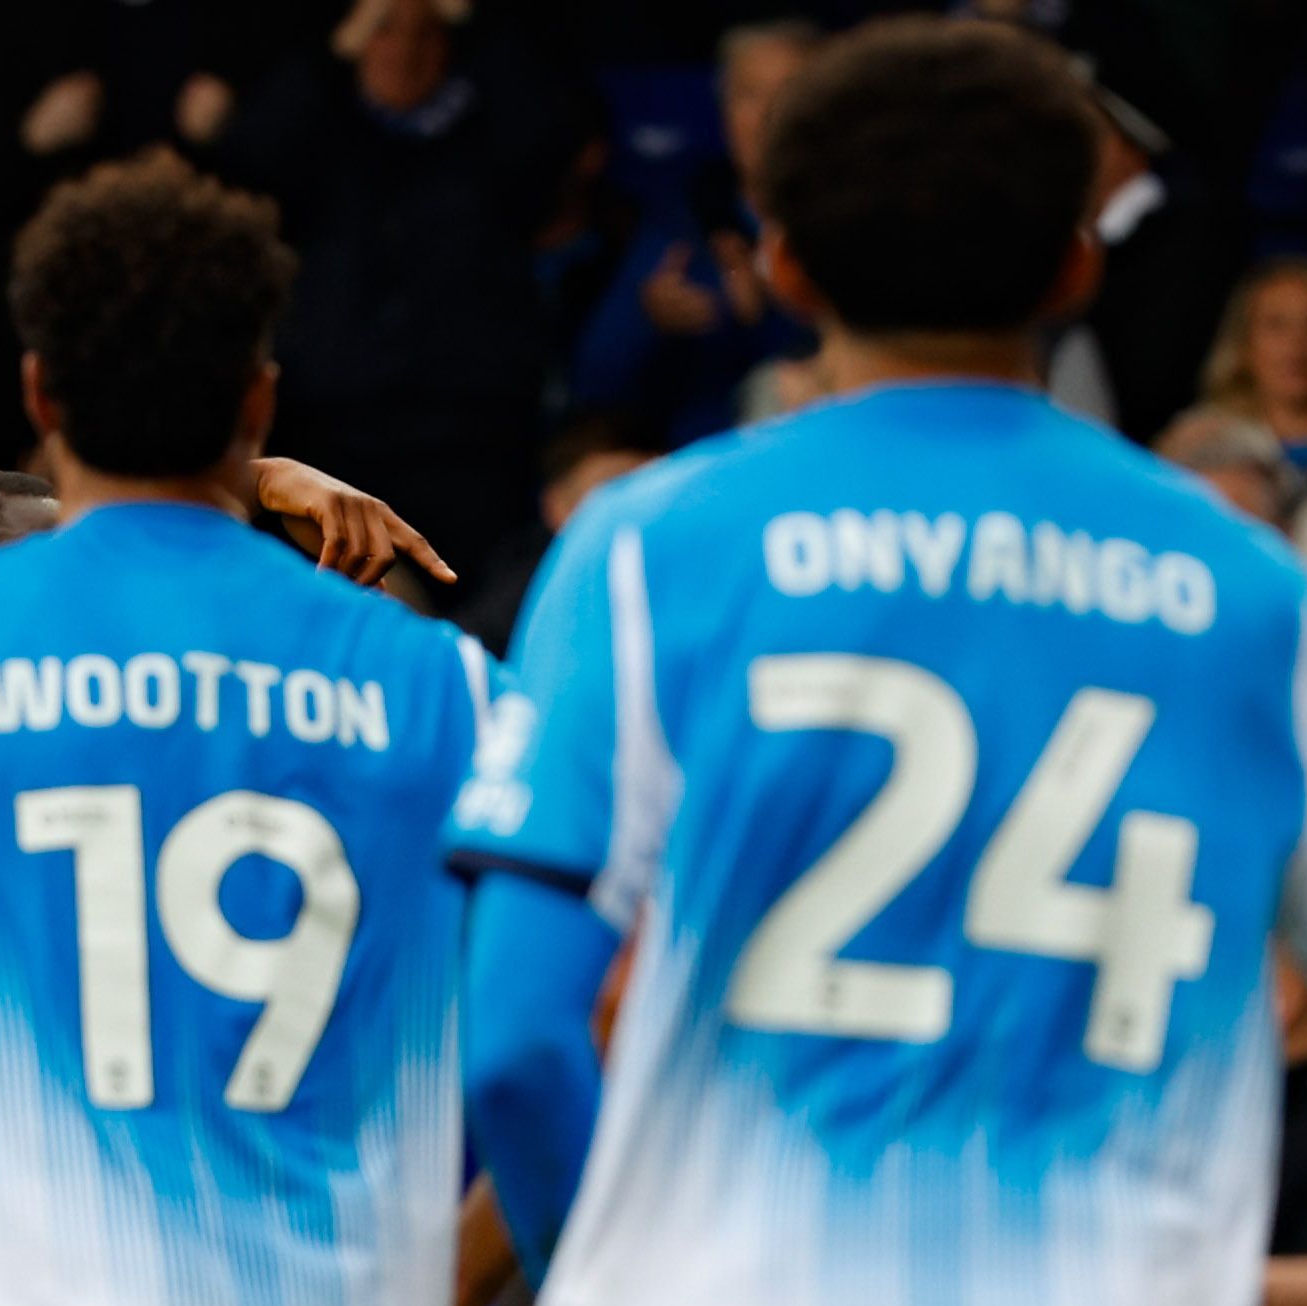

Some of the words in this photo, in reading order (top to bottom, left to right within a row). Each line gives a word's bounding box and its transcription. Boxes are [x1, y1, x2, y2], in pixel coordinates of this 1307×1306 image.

[762, 508, 1217, 635] ONYANGO
[14, 785, 361, 1112] 19
[725, 652, 1215, 1075] 24
